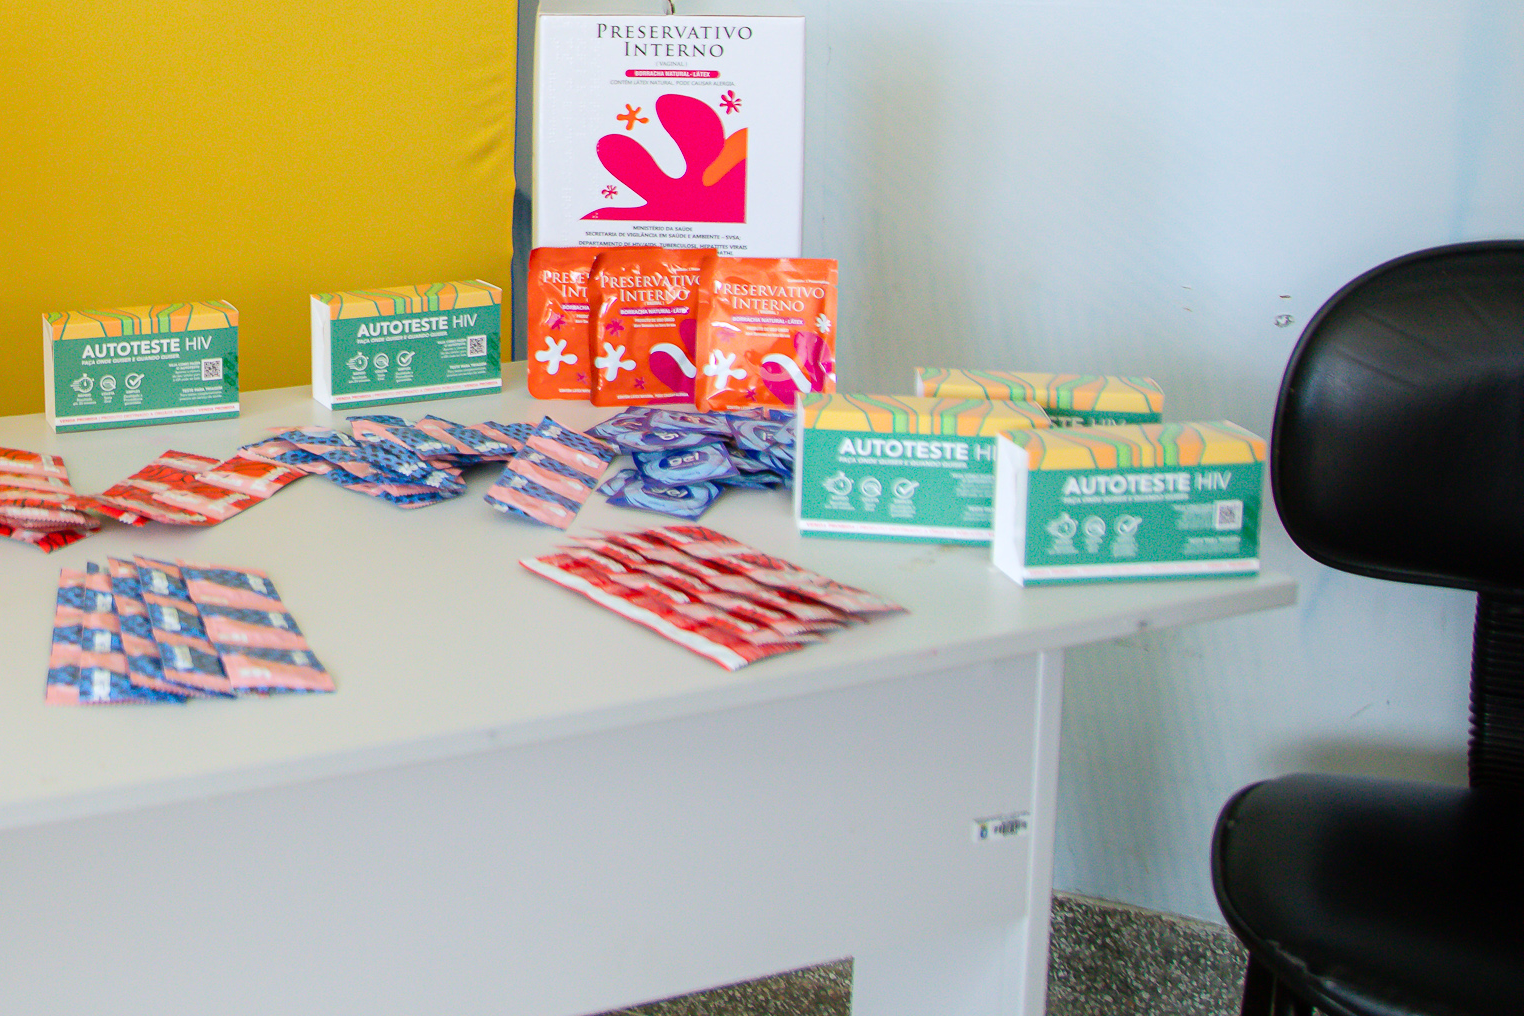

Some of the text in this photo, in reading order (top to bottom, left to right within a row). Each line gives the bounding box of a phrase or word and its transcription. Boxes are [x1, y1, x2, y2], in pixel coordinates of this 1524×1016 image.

[597, 23, 753, 40] PRESERVATIVO
[625, 42, 724, 57] INTERNO
[542, 270, 590, 284] PRESE
[619, 289, 689, 302] INTERNO
[732, 296, 805, 312] INTERNO
[357, 313, 477, 338] AUTOTESTE HIV
[82, 335, 212, 359] AUTOTESTE HIV
[81, 359, 96, 367] FAÇA
[839, 437, 996, 461] AUTOTESTE HI
[1063, 470, 1231, 496] AUTOTESTE HIV
